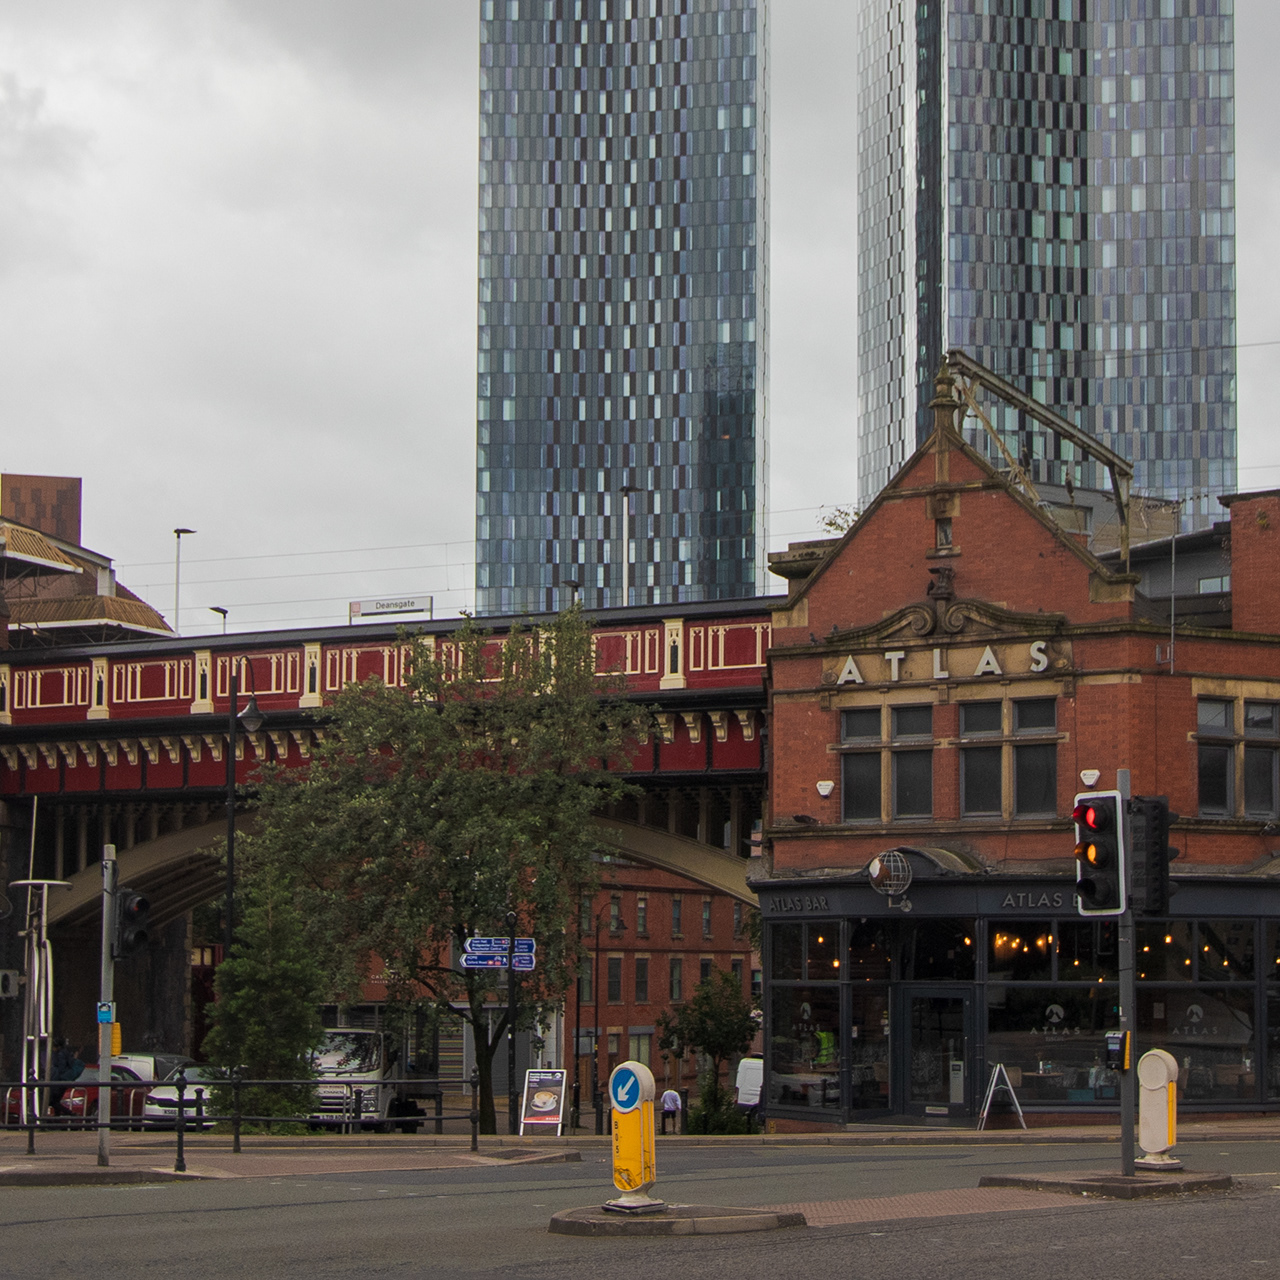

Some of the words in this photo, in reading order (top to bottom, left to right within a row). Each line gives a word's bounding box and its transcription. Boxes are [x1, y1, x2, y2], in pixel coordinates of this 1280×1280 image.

[376, 600, 415, 610] Deansgate
[837, 640, 1048, 684] ATLAS
[770, 897, 802, 911] ATLAS
[805, 896, 829, 911] BAR
[1002, 892, 1063, 907] ATLAS
[791, 1023, 821, 1032] ATLAS
[1029, 1026, 1081, 1035] ATLAS
[1172, 1026, 1219, 1035] ATLAS
